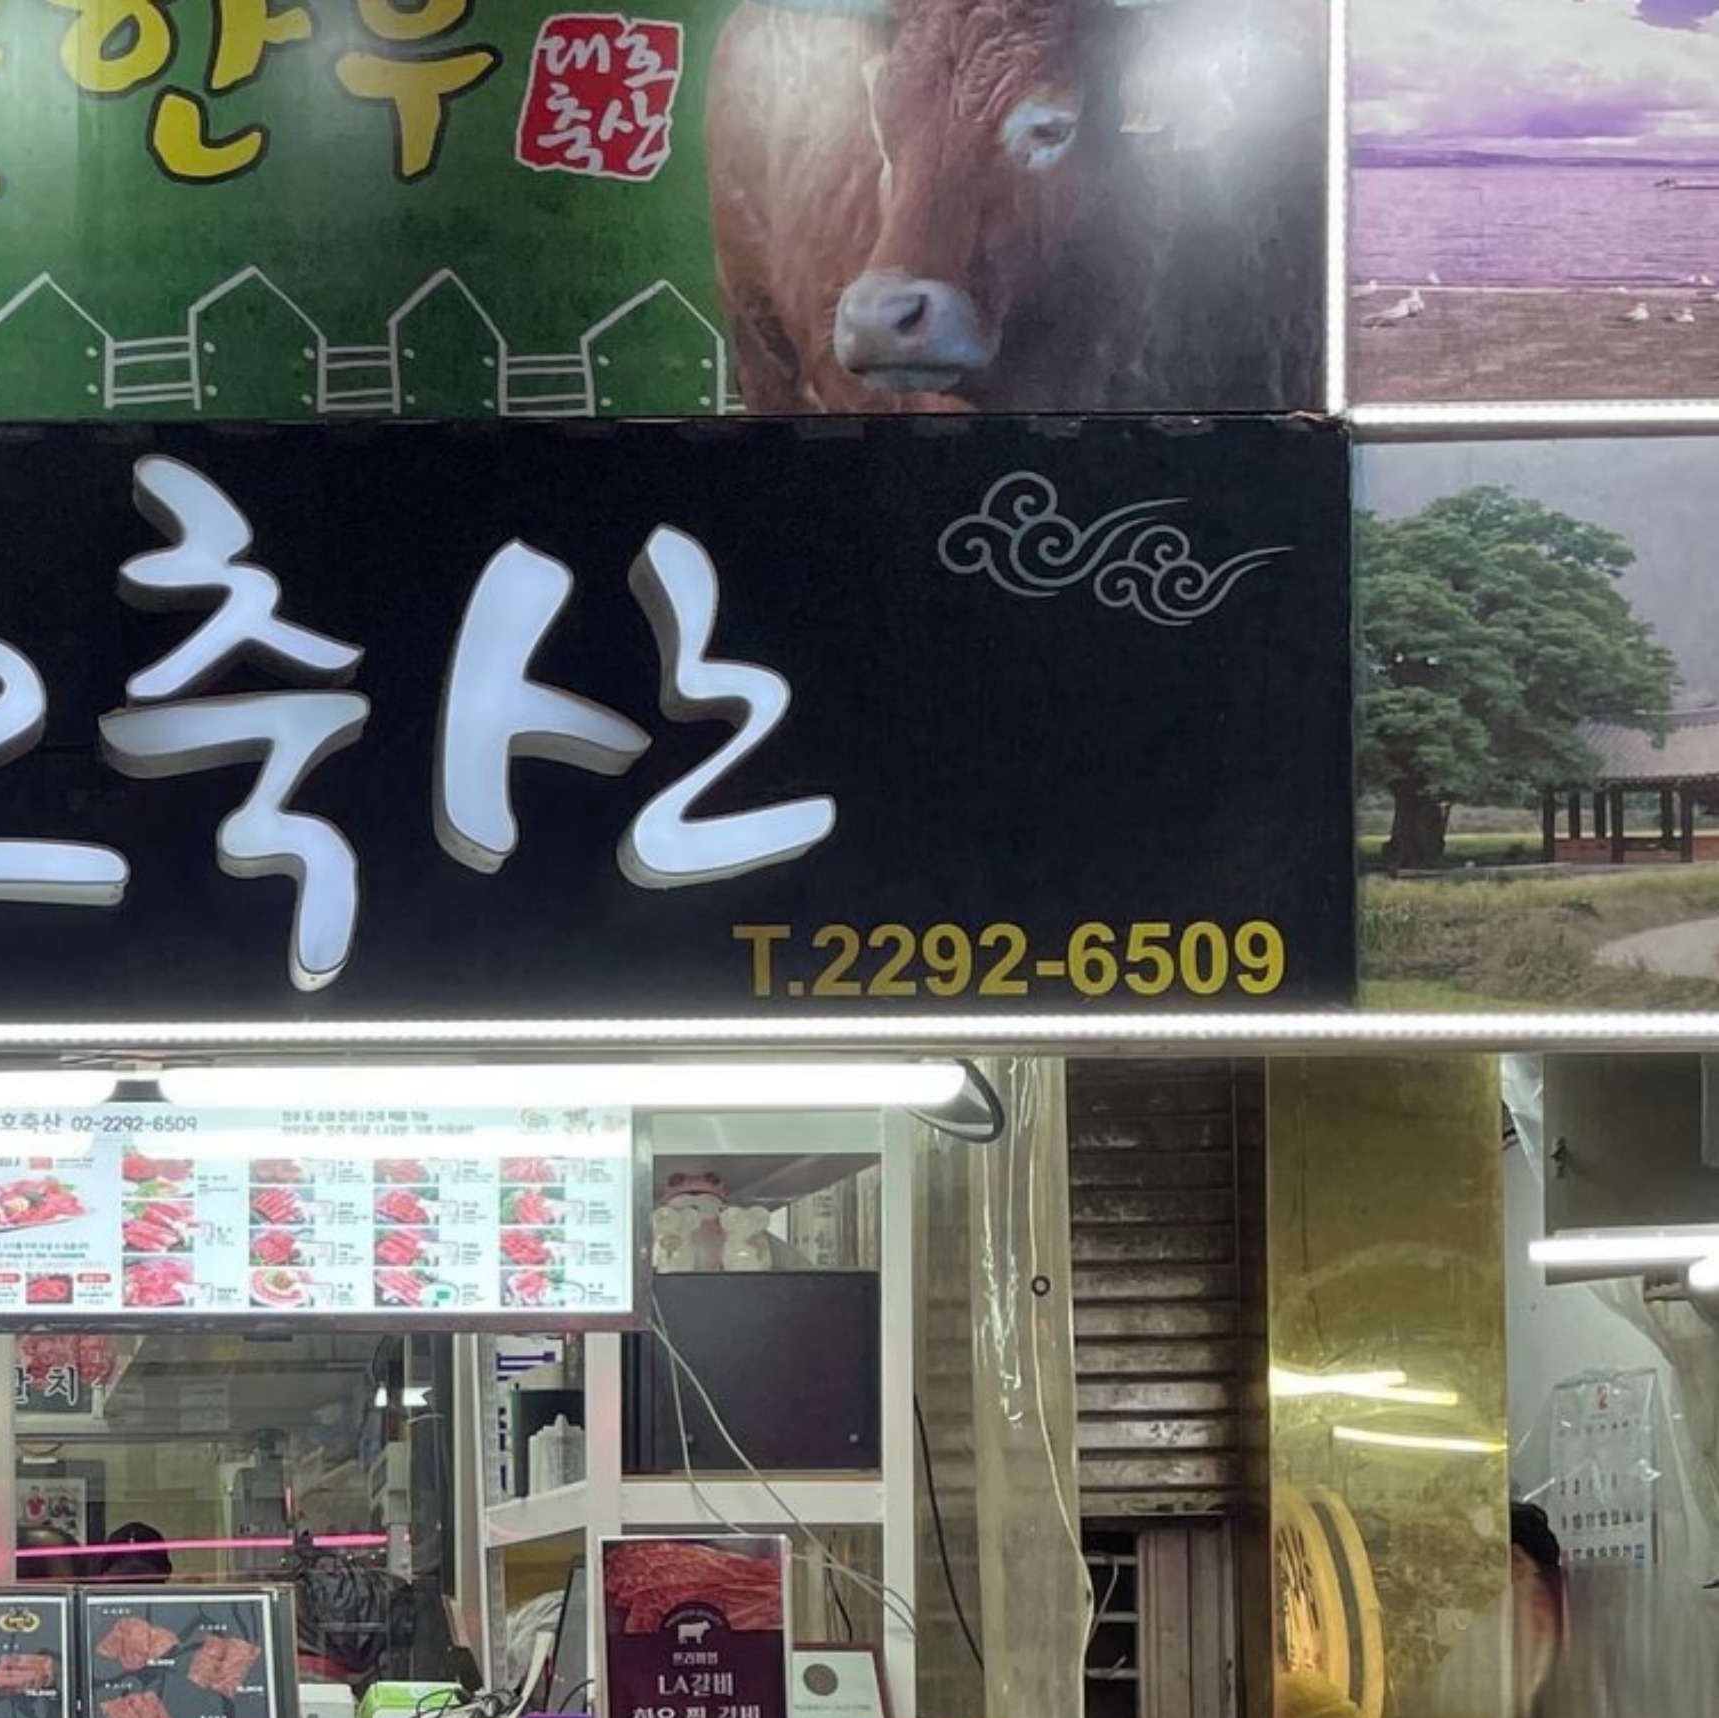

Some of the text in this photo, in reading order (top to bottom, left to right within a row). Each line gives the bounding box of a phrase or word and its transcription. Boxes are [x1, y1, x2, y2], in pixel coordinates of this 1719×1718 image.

[536, 32, 679, 92] 대호
[535, 81, 674, 180] 축산
[733, 921, 1286, 1000] T.2292-6509
[71, 1114, 199, 1134] 02-2292-6509
[672, 1651, 720, 1666] 프리미엄
[657, 1672, 734, 1697] LA갈비
